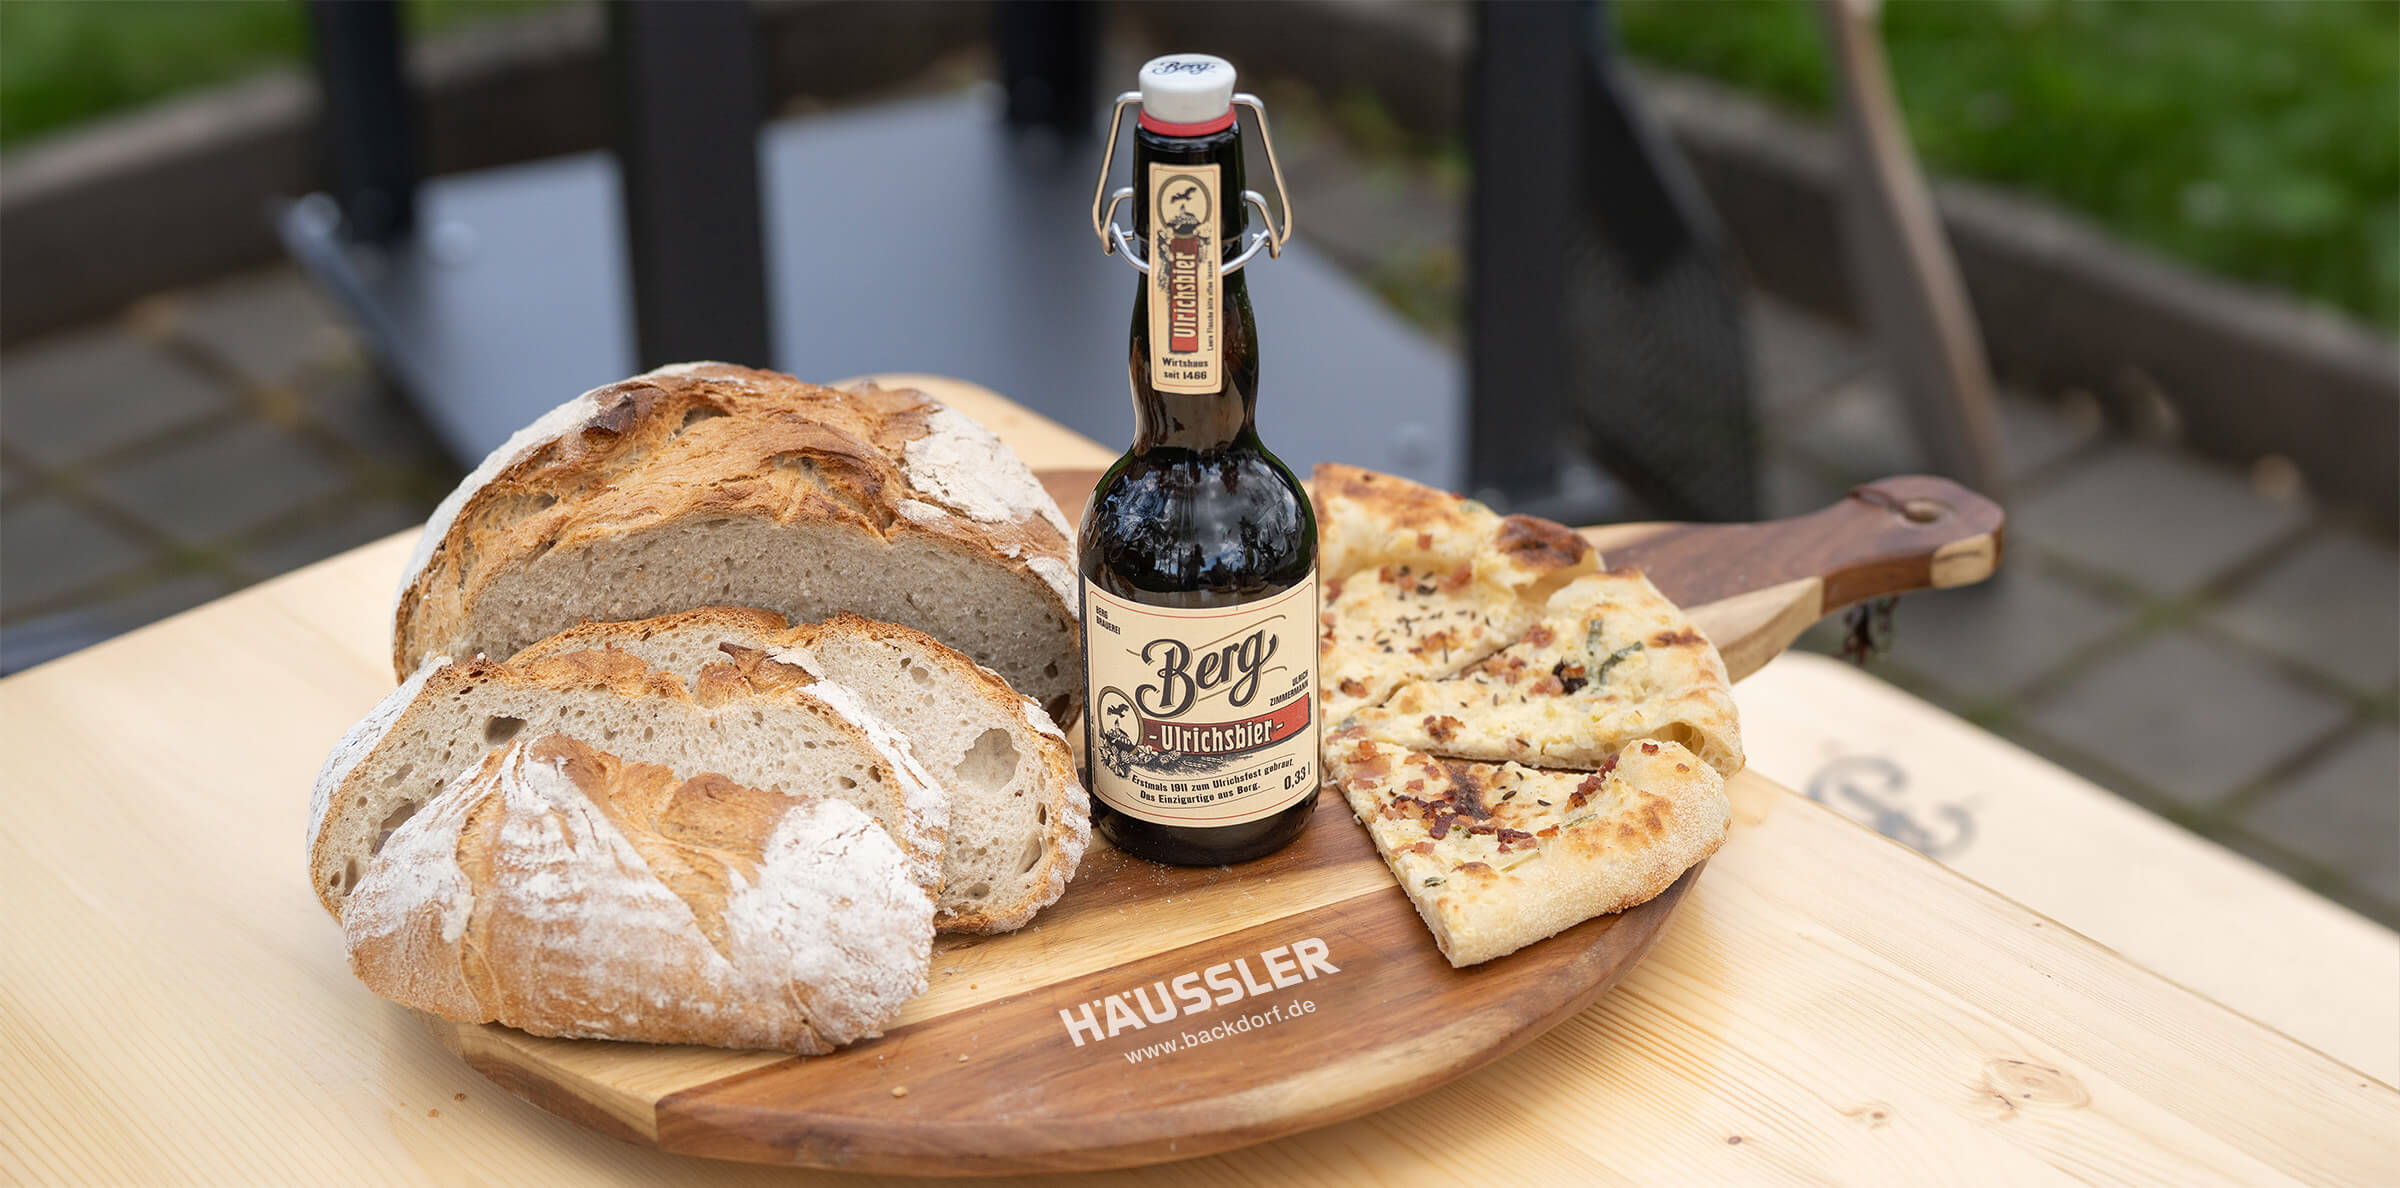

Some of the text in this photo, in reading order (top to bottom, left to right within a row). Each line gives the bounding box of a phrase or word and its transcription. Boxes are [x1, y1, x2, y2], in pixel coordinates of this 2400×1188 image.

[1152, 62, 1216, 75] Berg
[1173, 252, 1196, 338] Ulrichsbier
[1162, 357, 1208, 367] Wirtshaus
[1164, 371, 1179, 379] seit
[1095, 605, 1108, 619] BERG
[1096, 615, 1121, 635] BRAUEREI
[1135, 629, 1279, 718] Berg
[1292, 670, 1309, 687] ULRICH
[1270, 679, 1309, 706] ZIMMERMANN
[1131, 774, 1168, 792] Erstmals
[1170, 783, 1188, 792] 1911
[1191, 783, 1210, 792] zum
[1212, 769, 1262, 789] Ulrichsfest
[1140, 783, 1261, 805] Das Einzigartige aus Berg.
[1059, 937, 1341, 1047] HÄUSSLER
[1124, 999, 1317, 1064] www.backdorf.de
